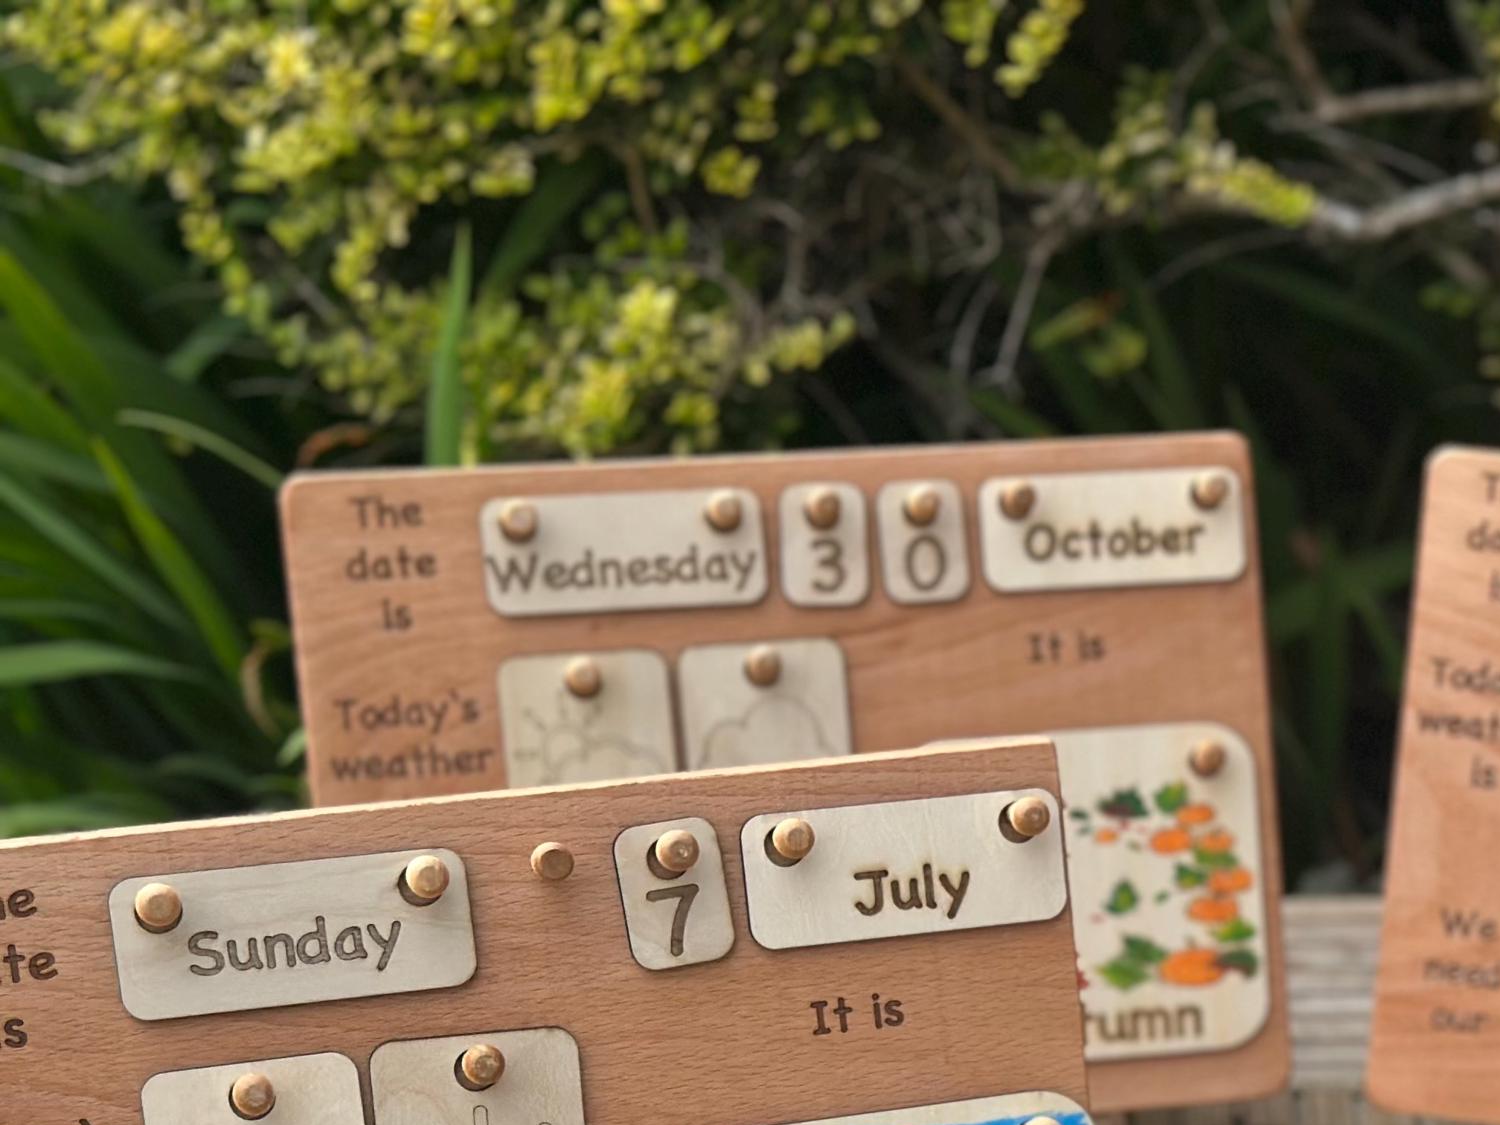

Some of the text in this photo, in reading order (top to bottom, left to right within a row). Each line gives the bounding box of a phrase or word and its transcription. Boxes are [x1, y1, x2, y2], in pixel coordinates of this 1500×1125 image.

[349, 496, 424, 530] The
[345, 548, 438, 583] date
[486, 543, 758, 594] Wednesday
[1023, 517, 1206, 563] October
[381, 600, 413, 632] is
[1026, 633, 1062, 664] It
[332, 689, 480, 735] Today's
[330, 744, 494, 781] weather
[187, 863, 971, 977] Sunday 7 July
[1440, 907, 1498, 943] We
[0, 944, 59, 984] te
[810, 993, 905, 1036] It is
[1084, 1004, 1204, 1041] umn
[1430, 1006, 1488, 1035] our
